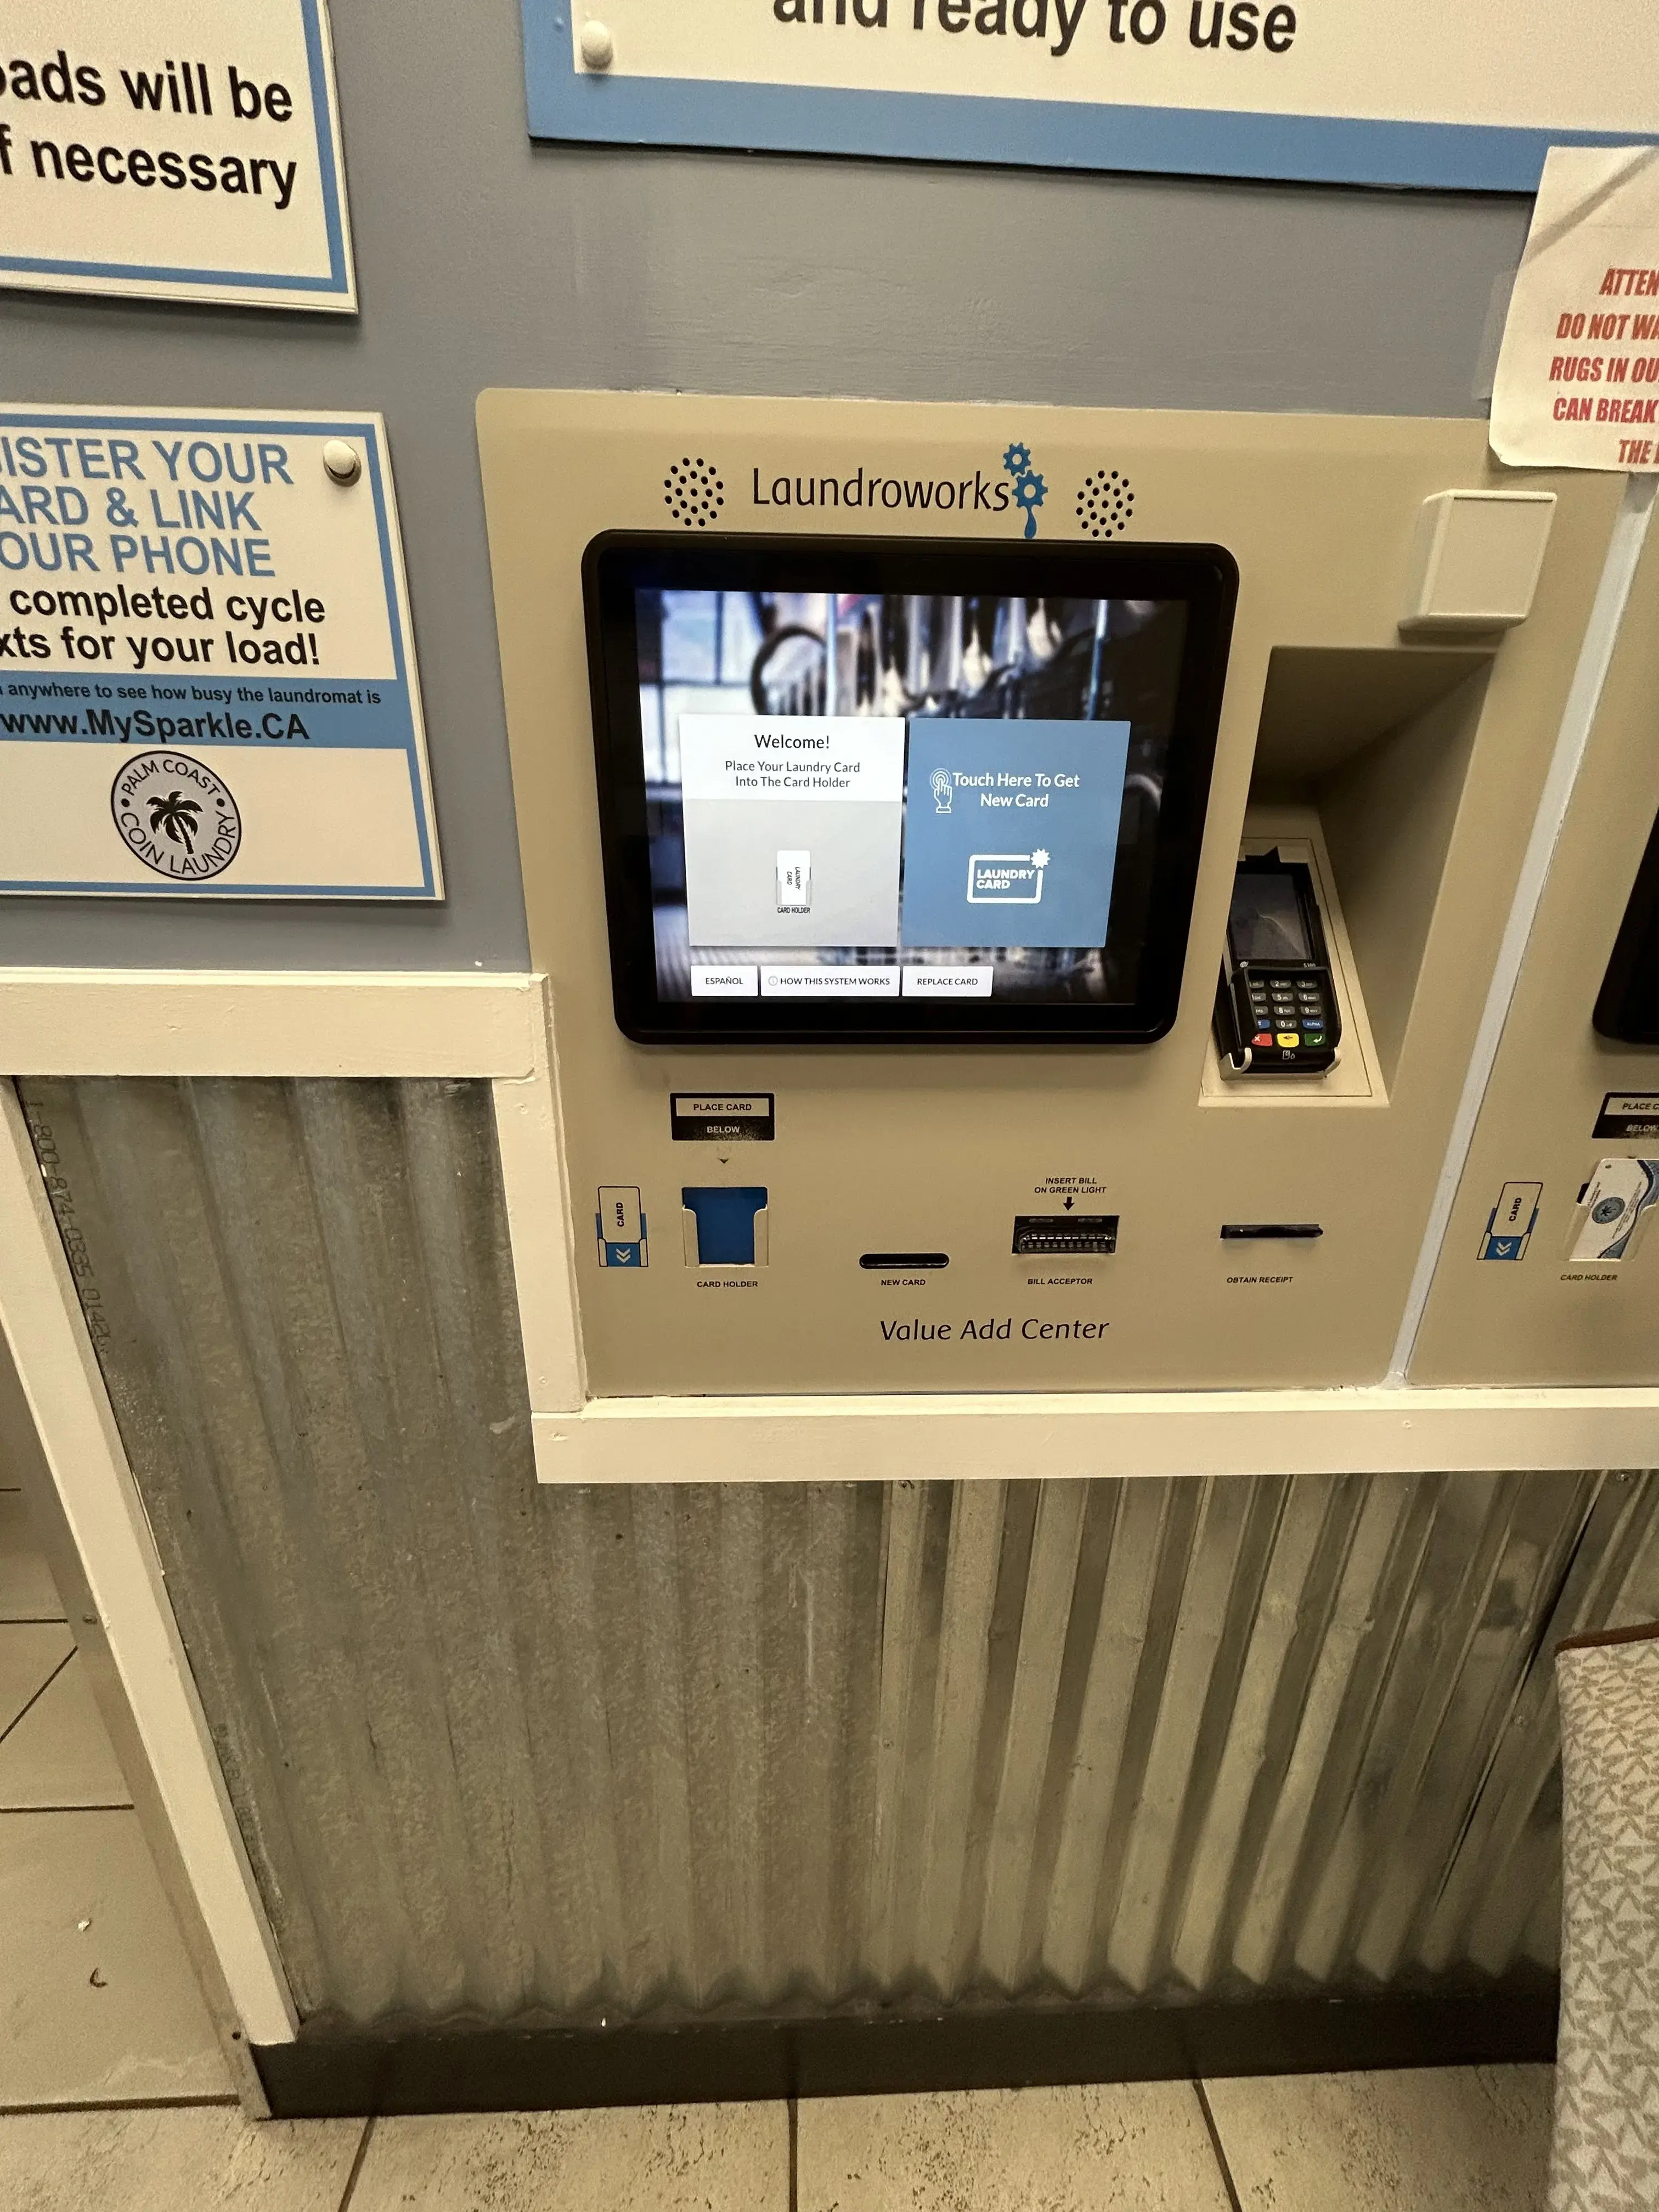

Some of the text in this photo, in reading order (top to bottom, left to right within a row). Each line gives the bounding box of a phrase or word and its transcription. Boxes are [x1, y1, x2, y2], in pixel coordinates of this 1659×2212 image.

[913, 0, 1085, 55] ready
[1109, 0, 1166, 44] to
[1189, 0, 1296, 53] use
[0, 49, 292, 121] ads will be
[31, 139, 297, 210] necessary
[1556, 313, 1586, 339] DO
[1587, 314, 1630, 340] NOT
[1549, 357, 1604, 381] RUGS
[1606, 358, 1629, 382] IN
[1553, 398, 1659, 423] CAN BREAK
[0, 436, 294, 484] ISTER YOUR
[1618, 439, 1653, 464] THE
[753, 467, 1009, 511] Laundroworks
[106, 487, 139, 527] &
[150, 489, 262, 531] LINK
[110, 535, 275, 577] PHONE
[10, 584, 325, 630] completed cycle
[61, 627, 115, 659] for
[126, 634, 214, 669] your
[226, 631, 319, 665] load!
[9, 682, 91, 699] anywhere
[95, 684, 112, 698] to
[117, 687, 146, 699] see
[151, 685, 187, 700] how
[191, 686, 232, 704] busy
[238, 687, 264, 702] the
[268, 687, 363, 704] laundromat
[367, 690, 381, 704] is
[754, 734, 830, 749] Welcome!
[121, 759, 221, 796] PALM COAST
[725, 761, 860, 774] Place Your Laundry Card
[952, 772, 1080, 788] Touch Here To Get
[736, 776, 850, 788] Into The Card Holder
[980, 793, 1049, 808] New Card
[121, 810, 236, 874] COIN LAUNDRY
[976, 879, 1011, 889] CARD
[977, 869, 1036, 879] LAUNDRY
[706, 977, 744, 985] ESPAÑOL
[955, 978, 979, 986] CARD
[1508, 1197, 1522, 1222] CARD
[879, 1318, 1110, 1341] Value Add Center
